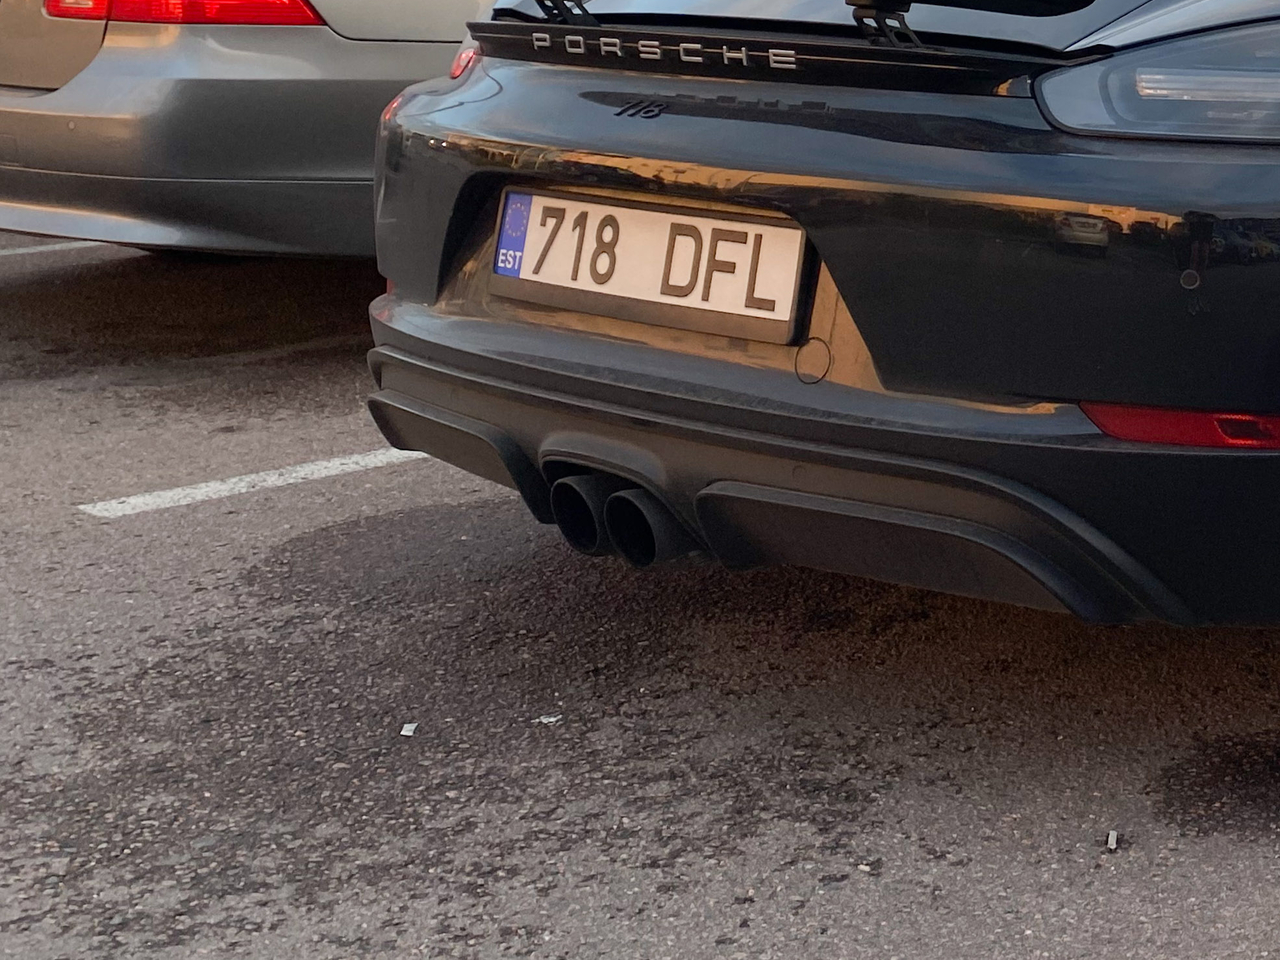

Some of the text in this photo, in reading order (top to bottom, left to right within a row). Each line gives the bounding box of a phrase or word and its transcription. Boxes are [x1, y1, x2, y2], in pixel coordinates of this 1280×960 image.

[532, 33, 797, 70] PORSCHE
[614, 99, 669, 119] 718
[498, 248, 523, 270] EST
[532, 206, 776, 312] 718 DFL
